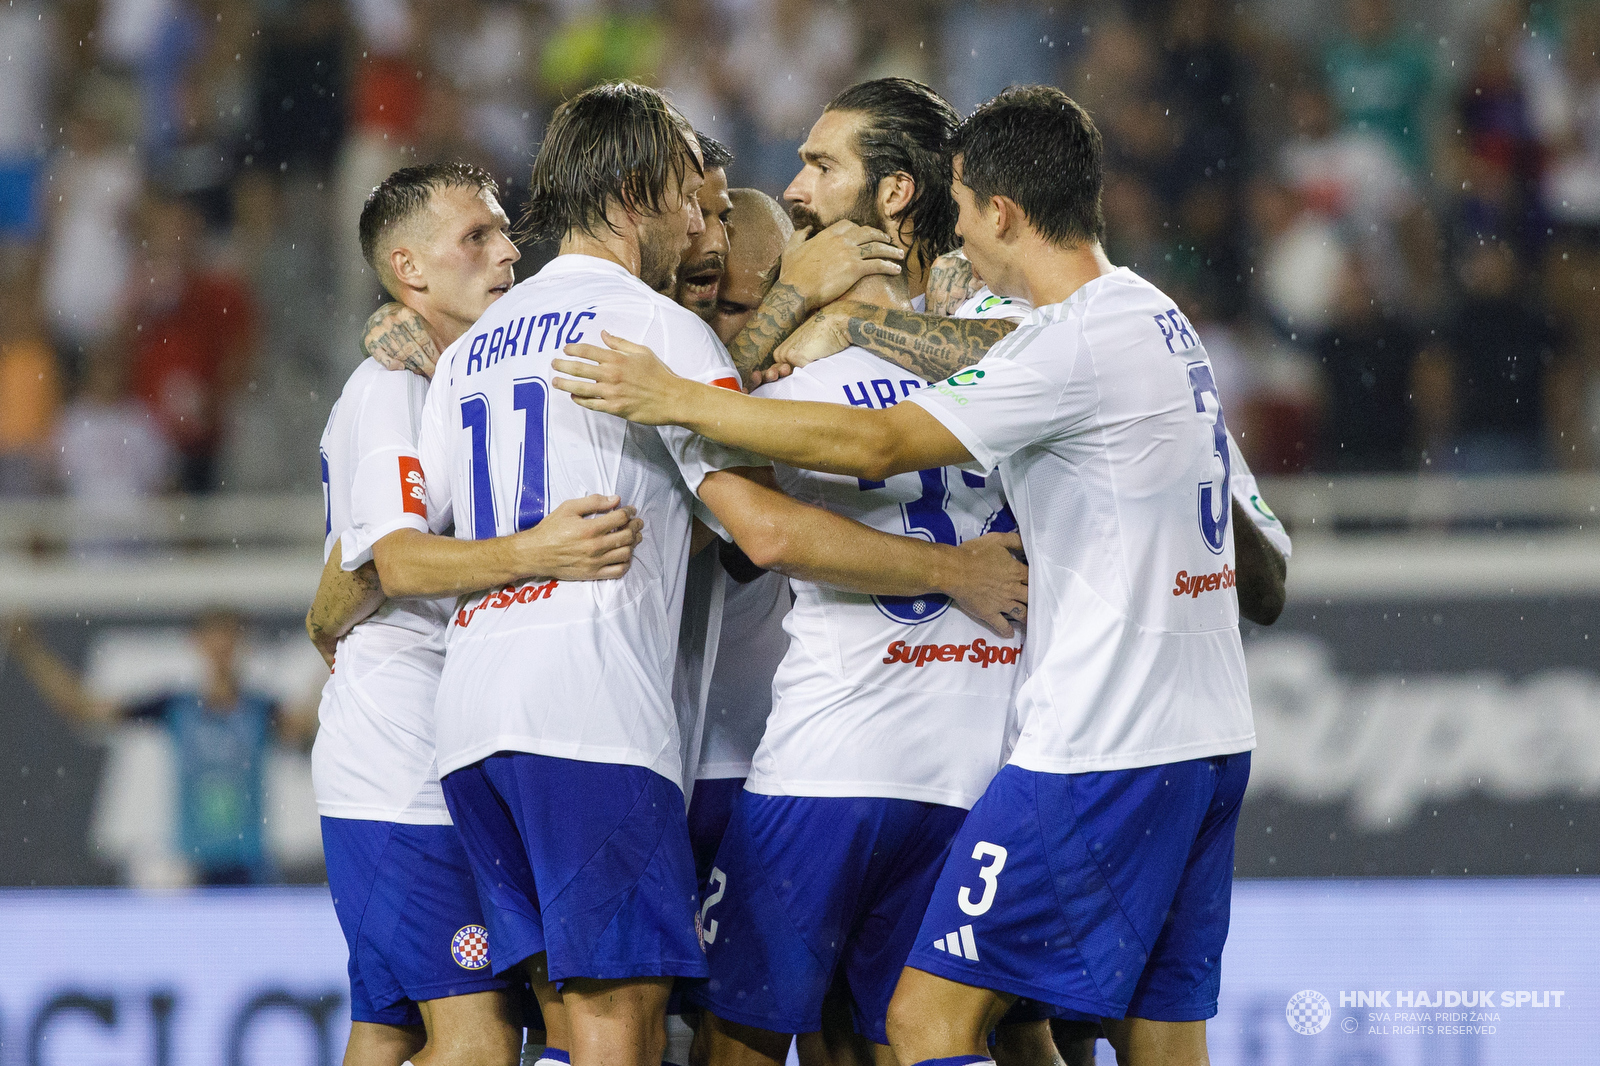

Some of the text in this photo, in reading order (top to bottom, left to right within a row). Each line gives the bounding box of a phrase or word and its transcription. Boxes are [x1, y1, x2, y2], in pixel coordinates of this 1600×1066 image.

[466, 305, 598, 376] RAKITIĆ
[459, 375, 549, 541] 11
[1186, 361, 1233, 555] 3
[957, 840, 1008, 917] 3
[460, 956, 489, 968] SPLIT
